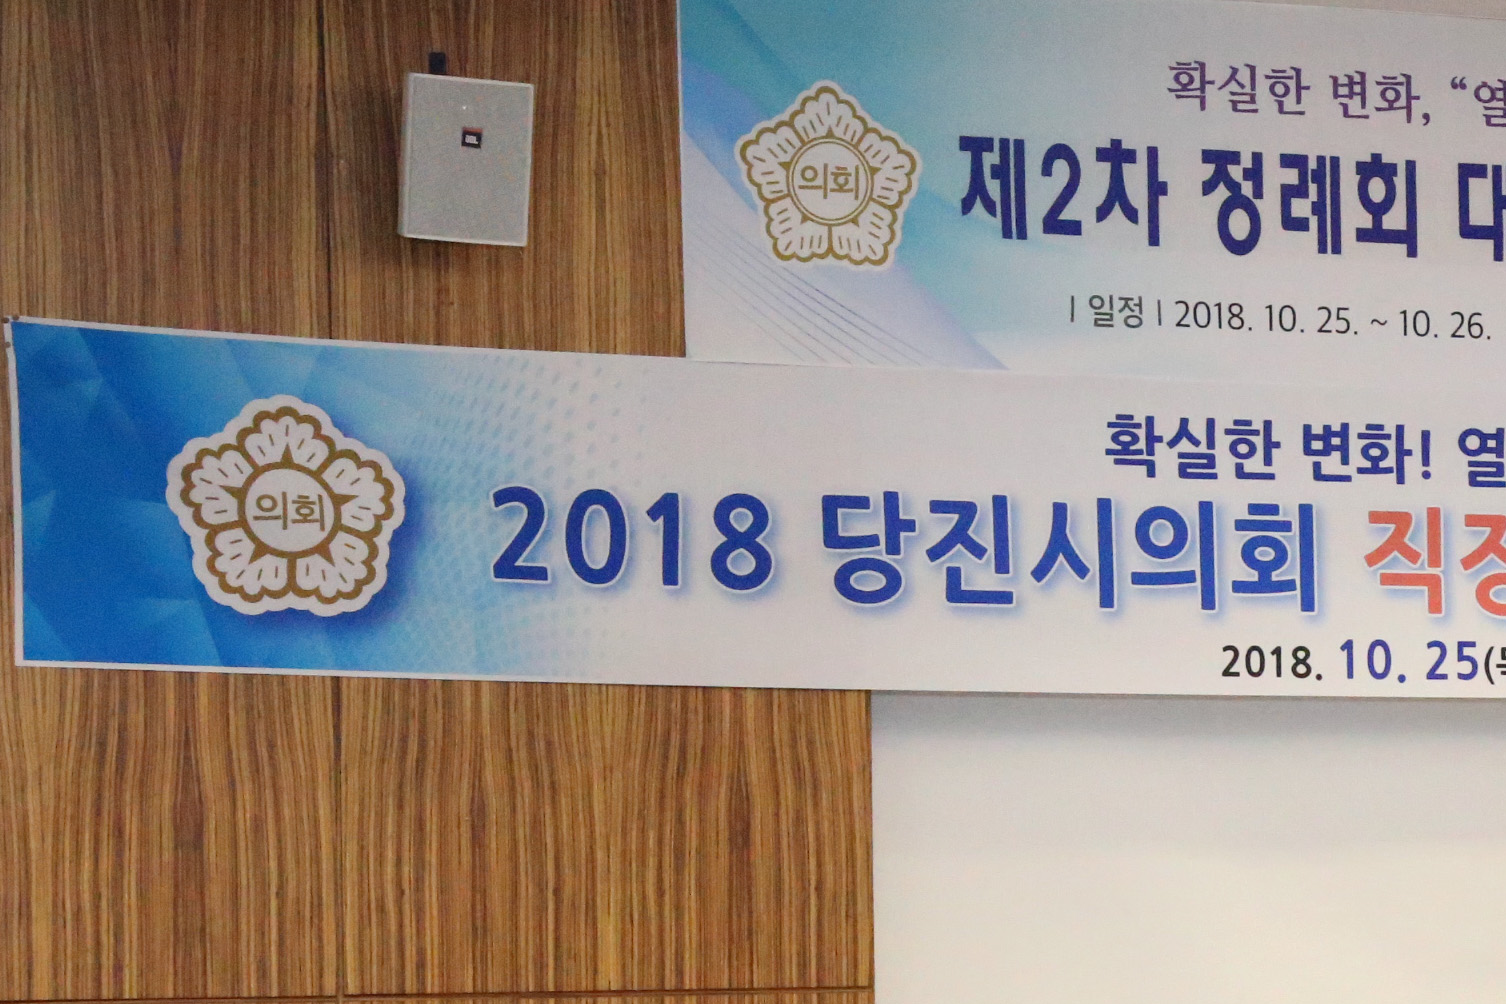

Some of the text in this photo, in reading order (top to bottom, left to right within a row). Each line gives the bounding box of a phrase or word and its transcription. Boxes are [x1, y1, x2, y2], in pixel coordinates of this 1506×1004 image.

[1166, 60, 1311, 117] 확실한
[1328, 71, 1431, 127] 변화,
[798, 162, 864, 199] 의회
[958, 135, 1169, 248] 제2차
[1201, 148, 1419, 260] 정례회
[1265, 304, 1306, 335] 10.
[1316, 306, 1359, 337] 25.
[1399, 309, 1441, 339] 10.
[1449, 311, 1493, 341] 26.
[1104, 413, 1282, 481] 확실한
[1301, 421, 1432, 484] 변화!
[255, 490, 327, 534] 의회
[490, 485, 775, 592] 2018
[821, 489, 1317, 614] 당진시의회
[1221, 645, 1323, 683] 2018.
[1338, 638, 1407, 684] 10.
